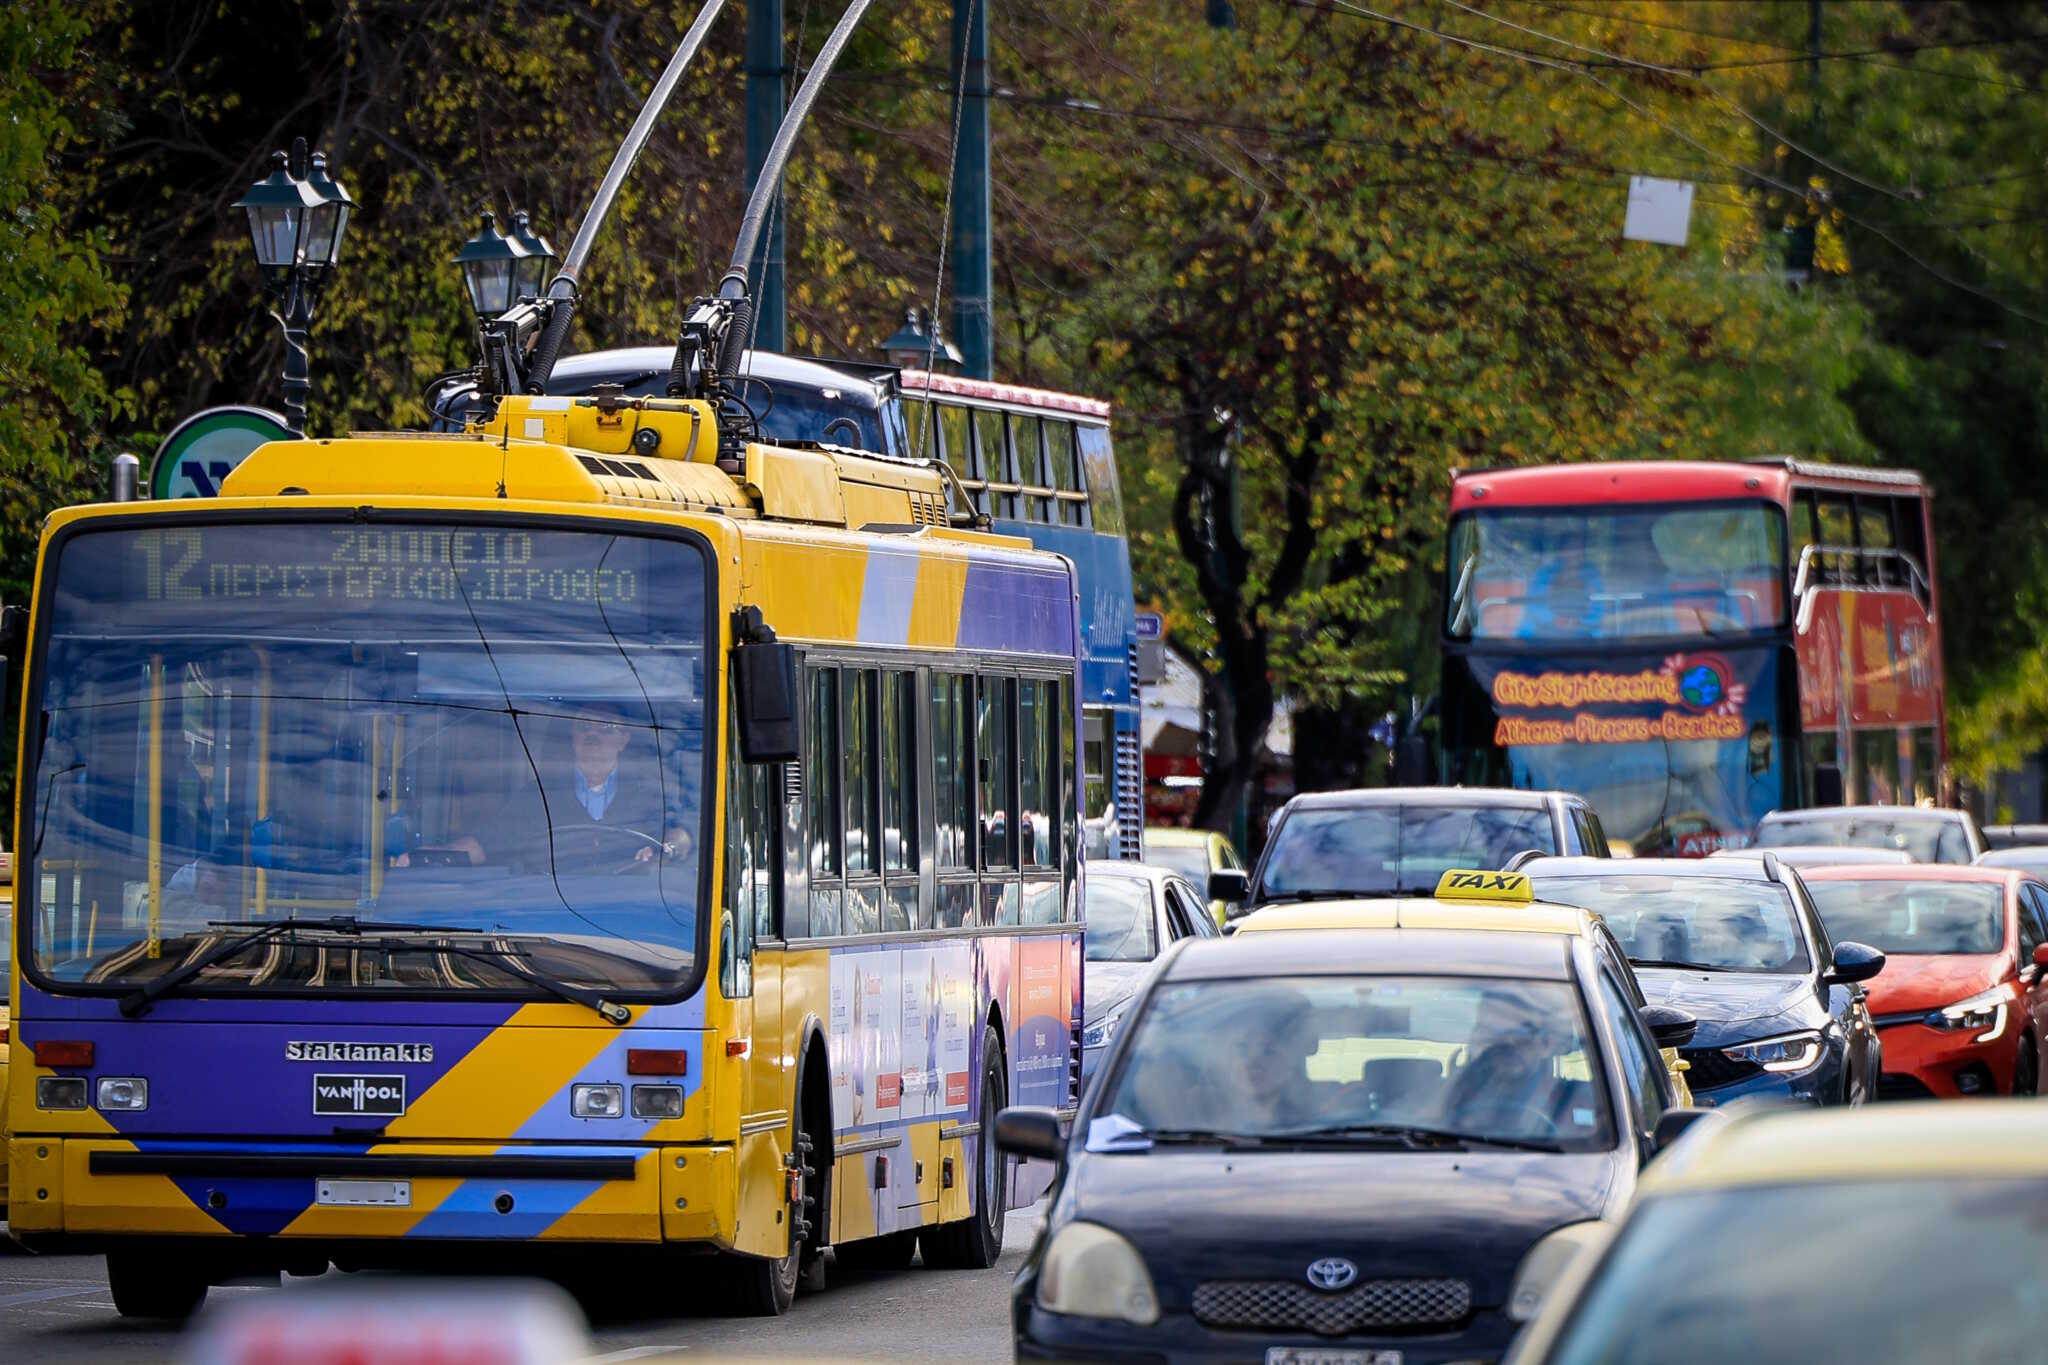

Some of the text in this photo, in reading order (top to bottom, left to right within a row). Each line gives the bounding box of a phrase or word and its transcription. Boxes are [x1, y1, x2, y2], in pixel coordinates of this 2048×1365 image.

[134, 528, 203, 600] 12
[331, 530, 532, 564] ΖΑΠΠΕΙΟ
[1494, 716, 1563, 746] Athens
[1662, 710, 1746, 740] Beaches
[1448, 873, 1524, 890] TAXI
[286, 1041, 433, 1062] Sfakianakis
